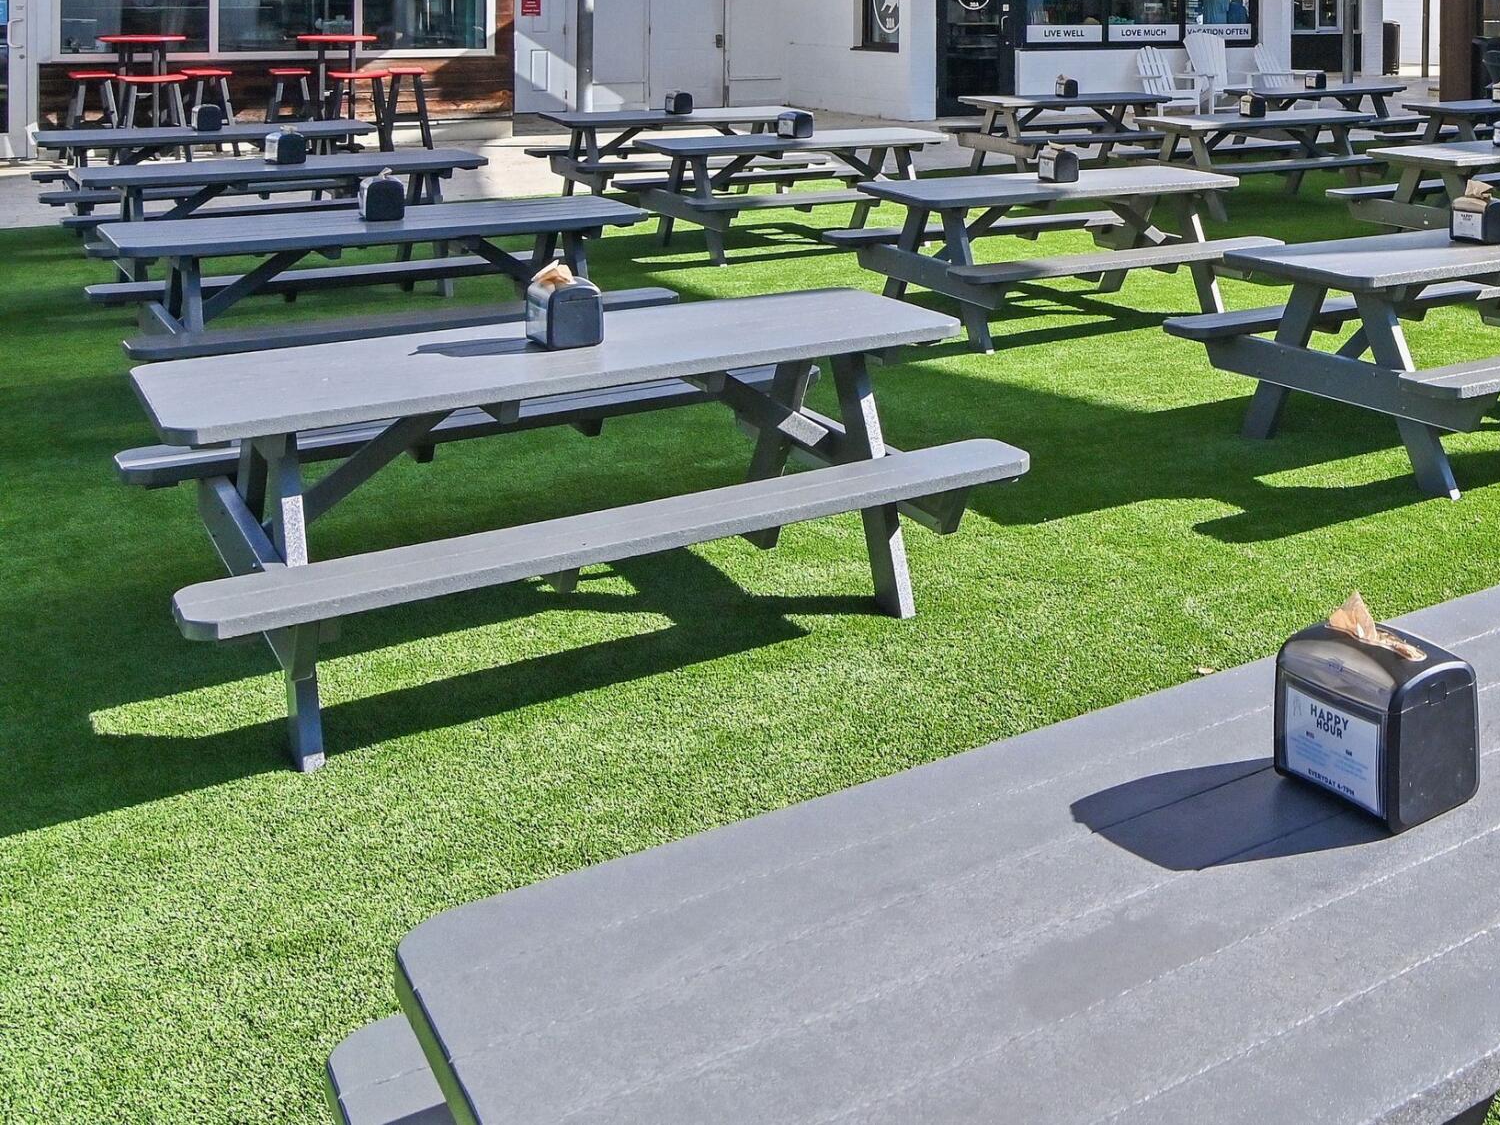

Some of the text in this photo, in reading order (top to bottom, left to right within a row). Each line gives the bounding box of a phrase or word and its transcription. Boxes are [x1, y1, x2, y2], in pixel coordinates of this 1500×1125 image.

[1044, 29, 1085, 37] LIVE WELL
[1121, 28, 1167, 37] LOVE MUCH
[1310, 704, 1349, 731] HAPPY
[1316, 719, 1342, 739] HOUR
